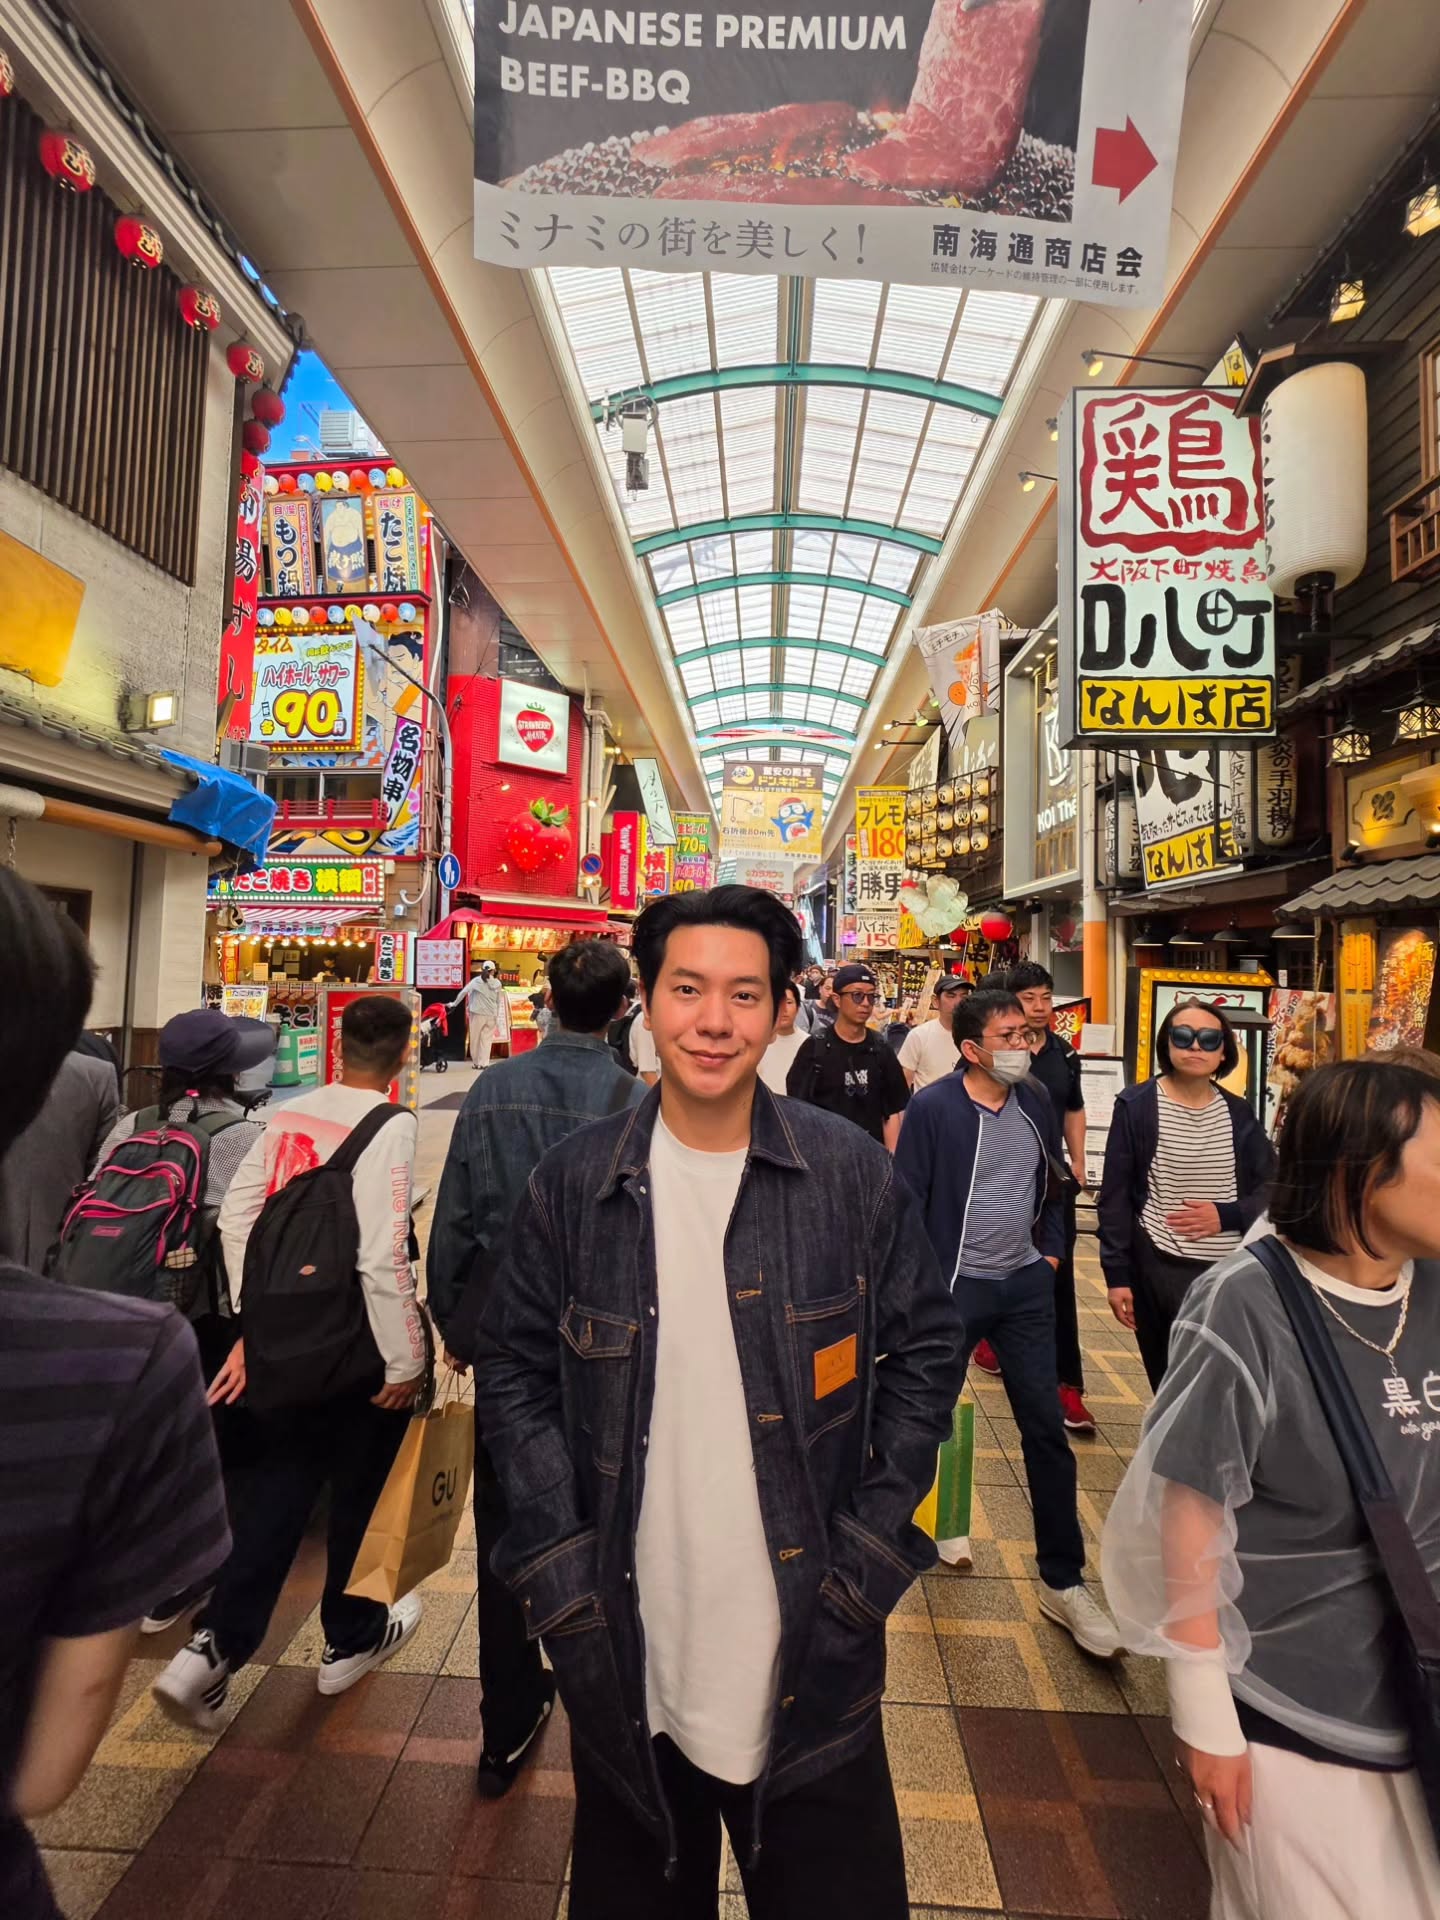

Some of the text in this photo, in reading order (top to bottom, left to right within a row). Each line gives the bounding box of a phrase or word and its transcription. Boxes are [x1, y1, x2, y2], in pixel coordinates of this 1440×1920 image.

[498, 0, 907, 51] JAPANESE PREMIUM
[500, 55, 691, 105] BEEF-BBQ
[931, 223, 1144, 279] 南海通商店会
[1099, 396, 1250, 531] 鶏
[1090, 556, 1267, 585] 大阪下町焼鳥
[1086, 684, 1269, 729] なんば店
[233, 868, 313, 893] たこ焼き
[432, 1465, 458, 1507] GU
